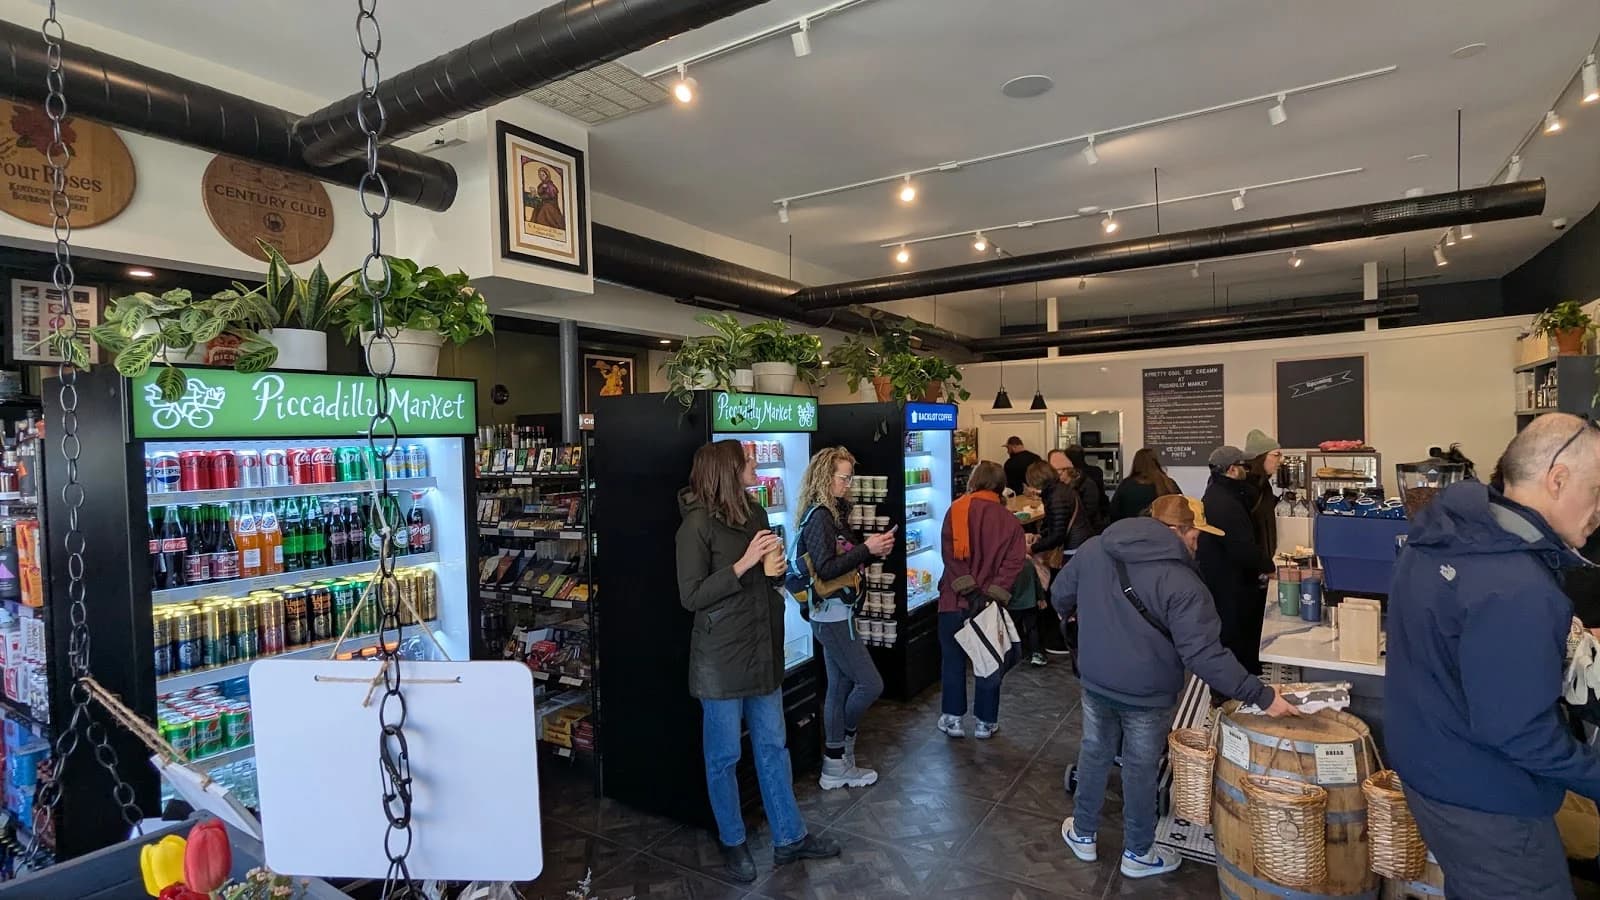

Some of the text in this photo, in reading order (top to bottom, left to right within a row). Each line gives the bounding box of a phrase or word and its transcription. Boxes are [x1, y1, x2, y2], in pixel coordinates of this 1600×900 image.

[0, 161, 40, 181] our
[213, 183, 327, 217] CENTURY CLUB
[251, 375, 465, 434] Piccadilly Market
[760, 399, 793, 424] Market
[918, 412, 953, 422] BACKLOT COFFEE
[154, 468, 181, 476] PEPS
